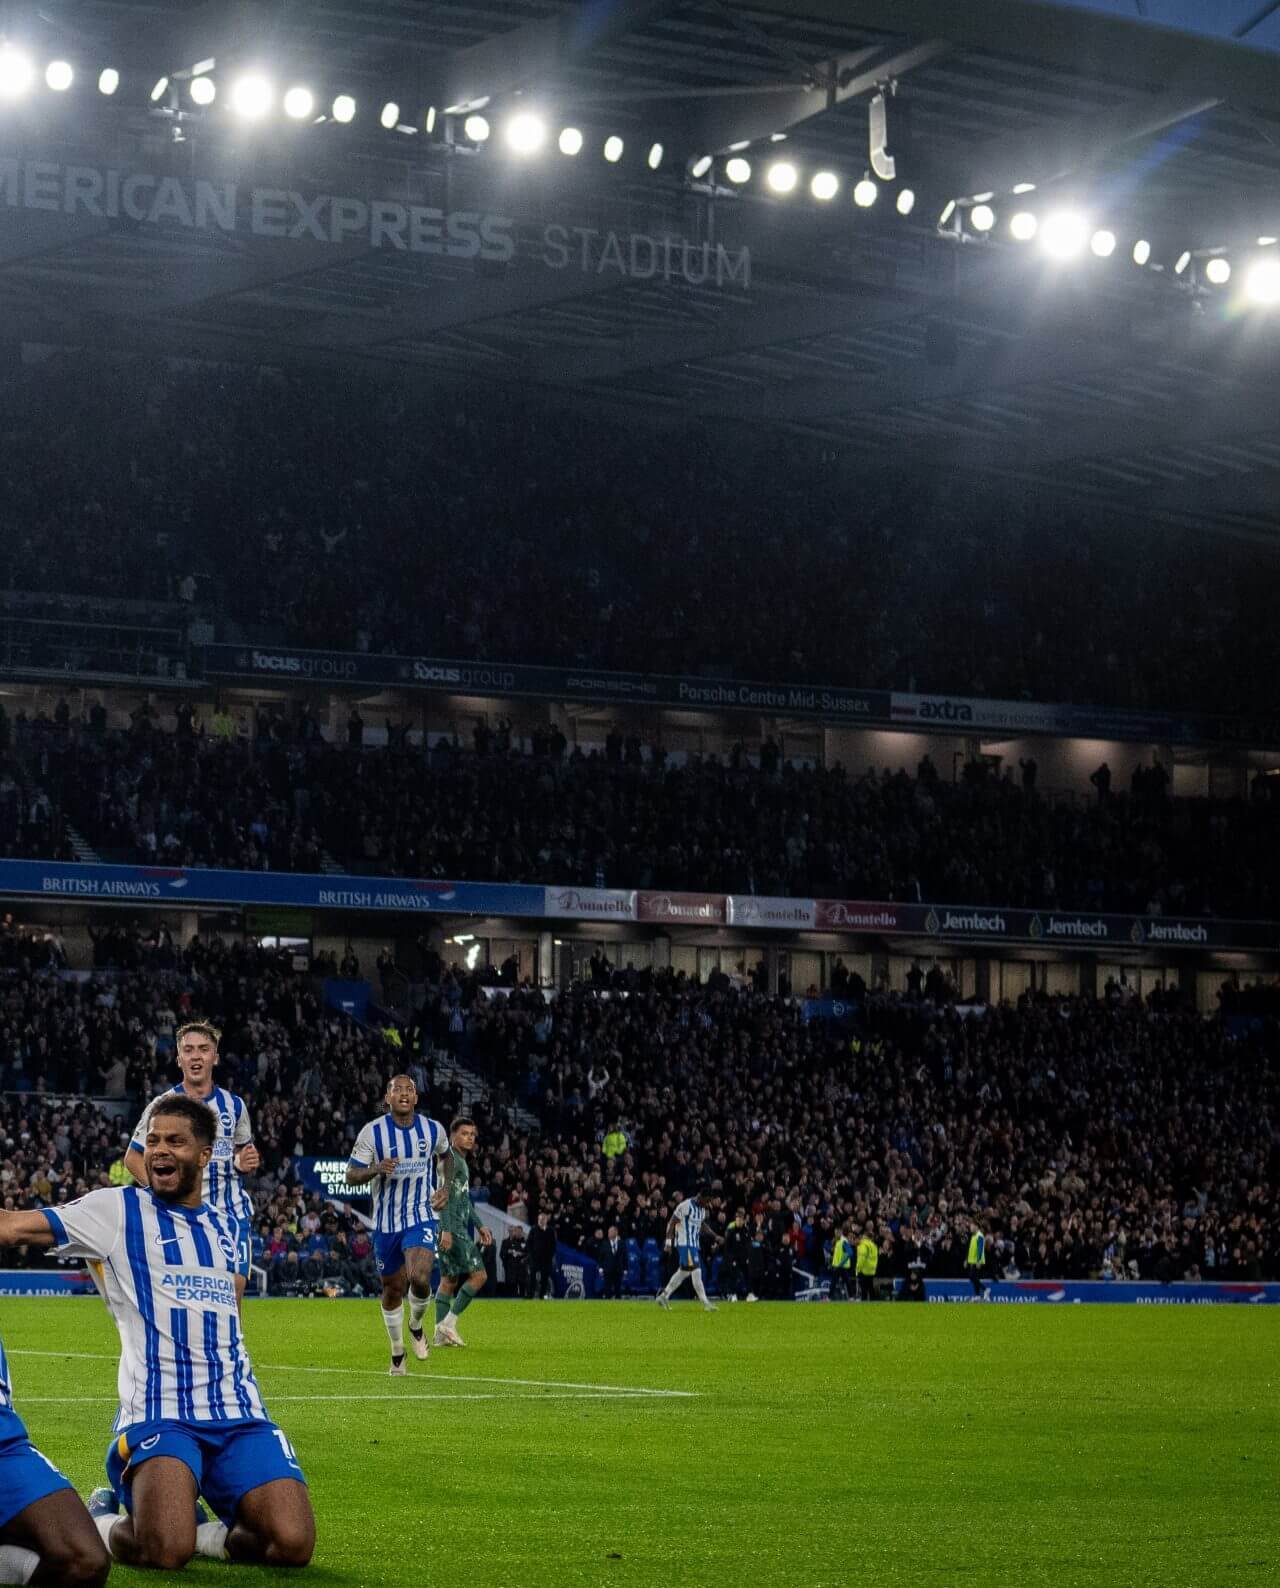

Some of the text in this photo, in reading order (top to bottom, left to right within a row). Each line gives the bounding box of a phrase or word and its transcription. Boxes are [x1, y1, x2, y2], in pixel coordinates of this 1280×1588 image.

[251, 188, 516, 262] EXPRESS
[543, 224, 752, 290] STADIUM
[679, 683, 736, 704] Porsche
[739, 688, 786, 706] Centre
[918, 700, 973, 721] axtra
[42, 877, 161, 896] BRITISH AIRWAYS
[318, 890, 431, 909] BRITISH AIRWAYS
[830, 902, 897, 927] Donatello
[942, 911, 1005, 932] Jemtech
[1046, 917, 1108, 938] Jemtech
[1147, 922, 1207, 943] Jemtech
[327, 1183, 371, 1195] STADIUM
[161, 1274, 235, 1292] AMERICAN
[176, 1288, 237, 1308] EXPRESS
